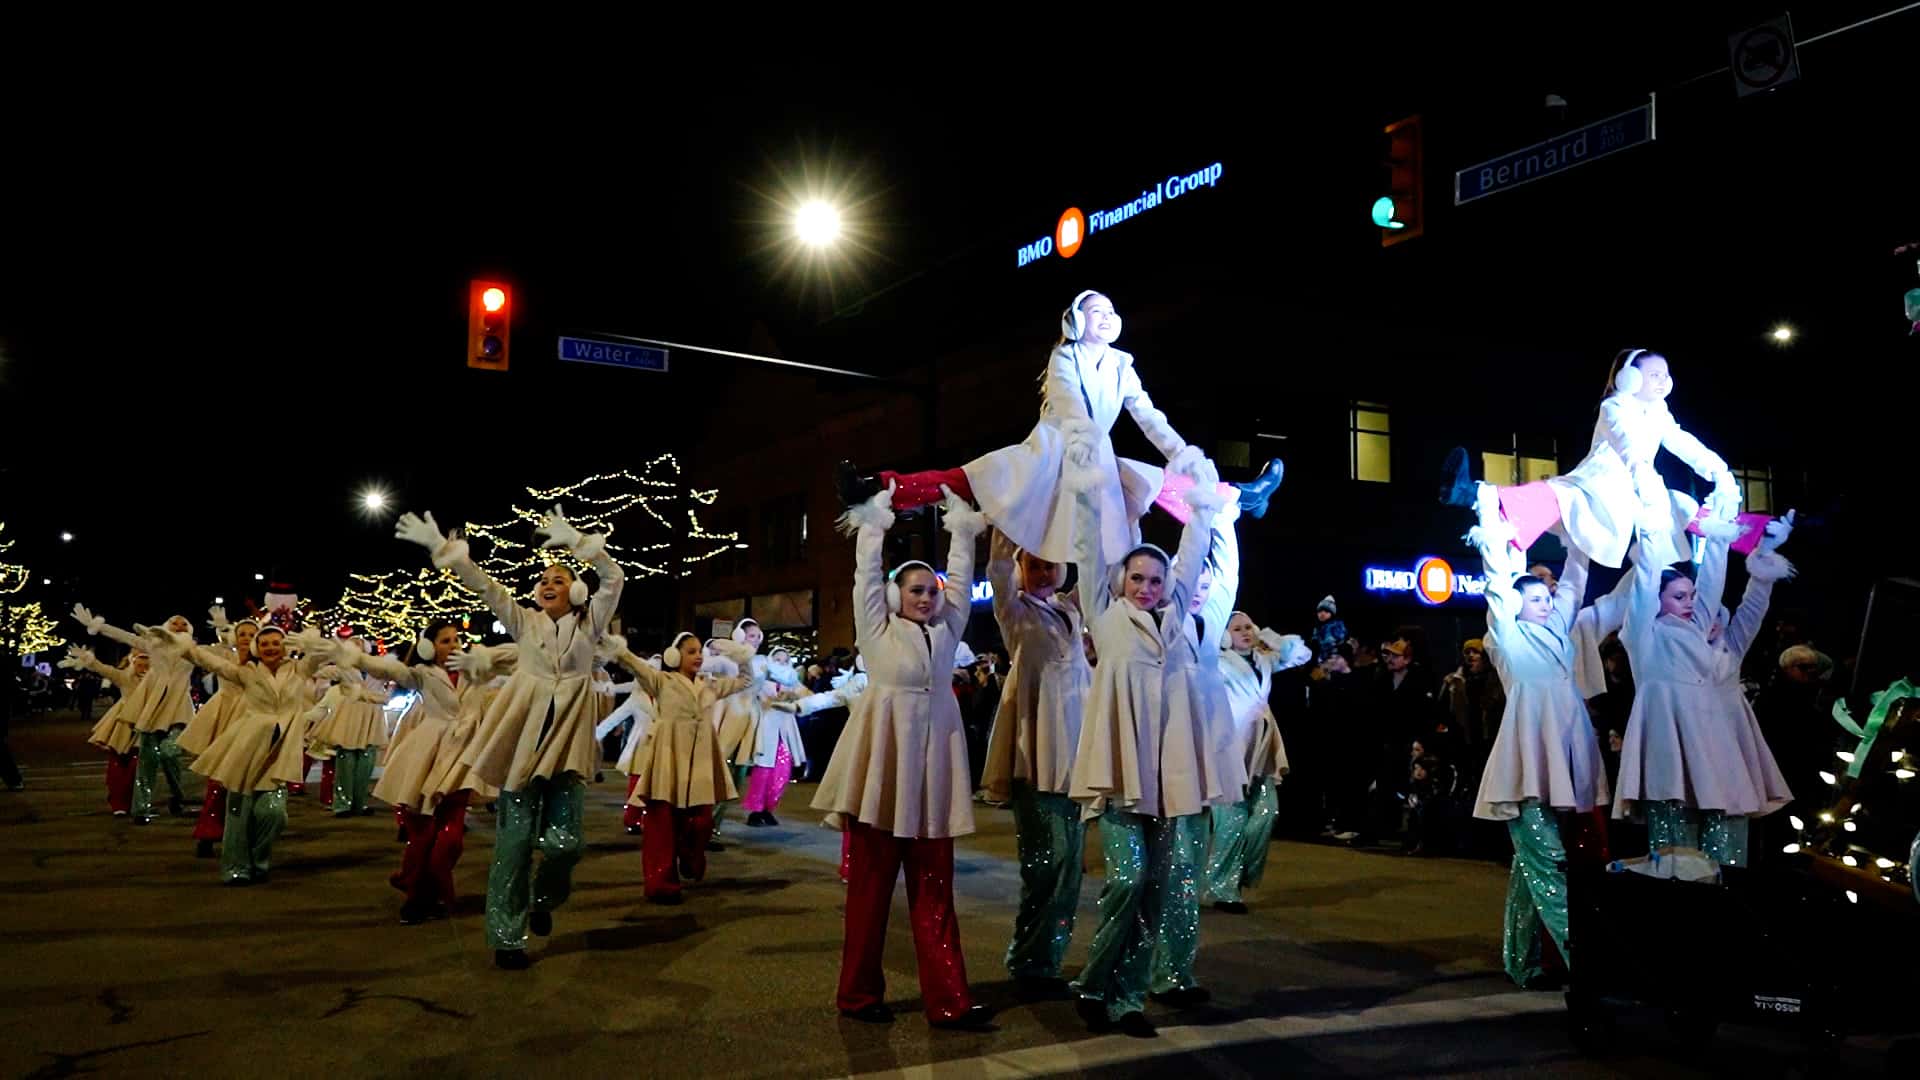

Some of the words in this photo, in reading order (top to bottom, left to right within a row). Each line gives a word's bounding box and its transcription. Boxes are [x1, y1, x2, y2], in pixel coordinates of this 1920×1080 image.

[1479, 132, 1588, 191] Bernard
[1017, 236, 1053, 268] BMO
[1088, 183, 1162, 235] Financial
[1165, 162, 1223, 199] Group
[574, 341, 632, 363] Water
[1367, 568, 1416, 590] BMO
